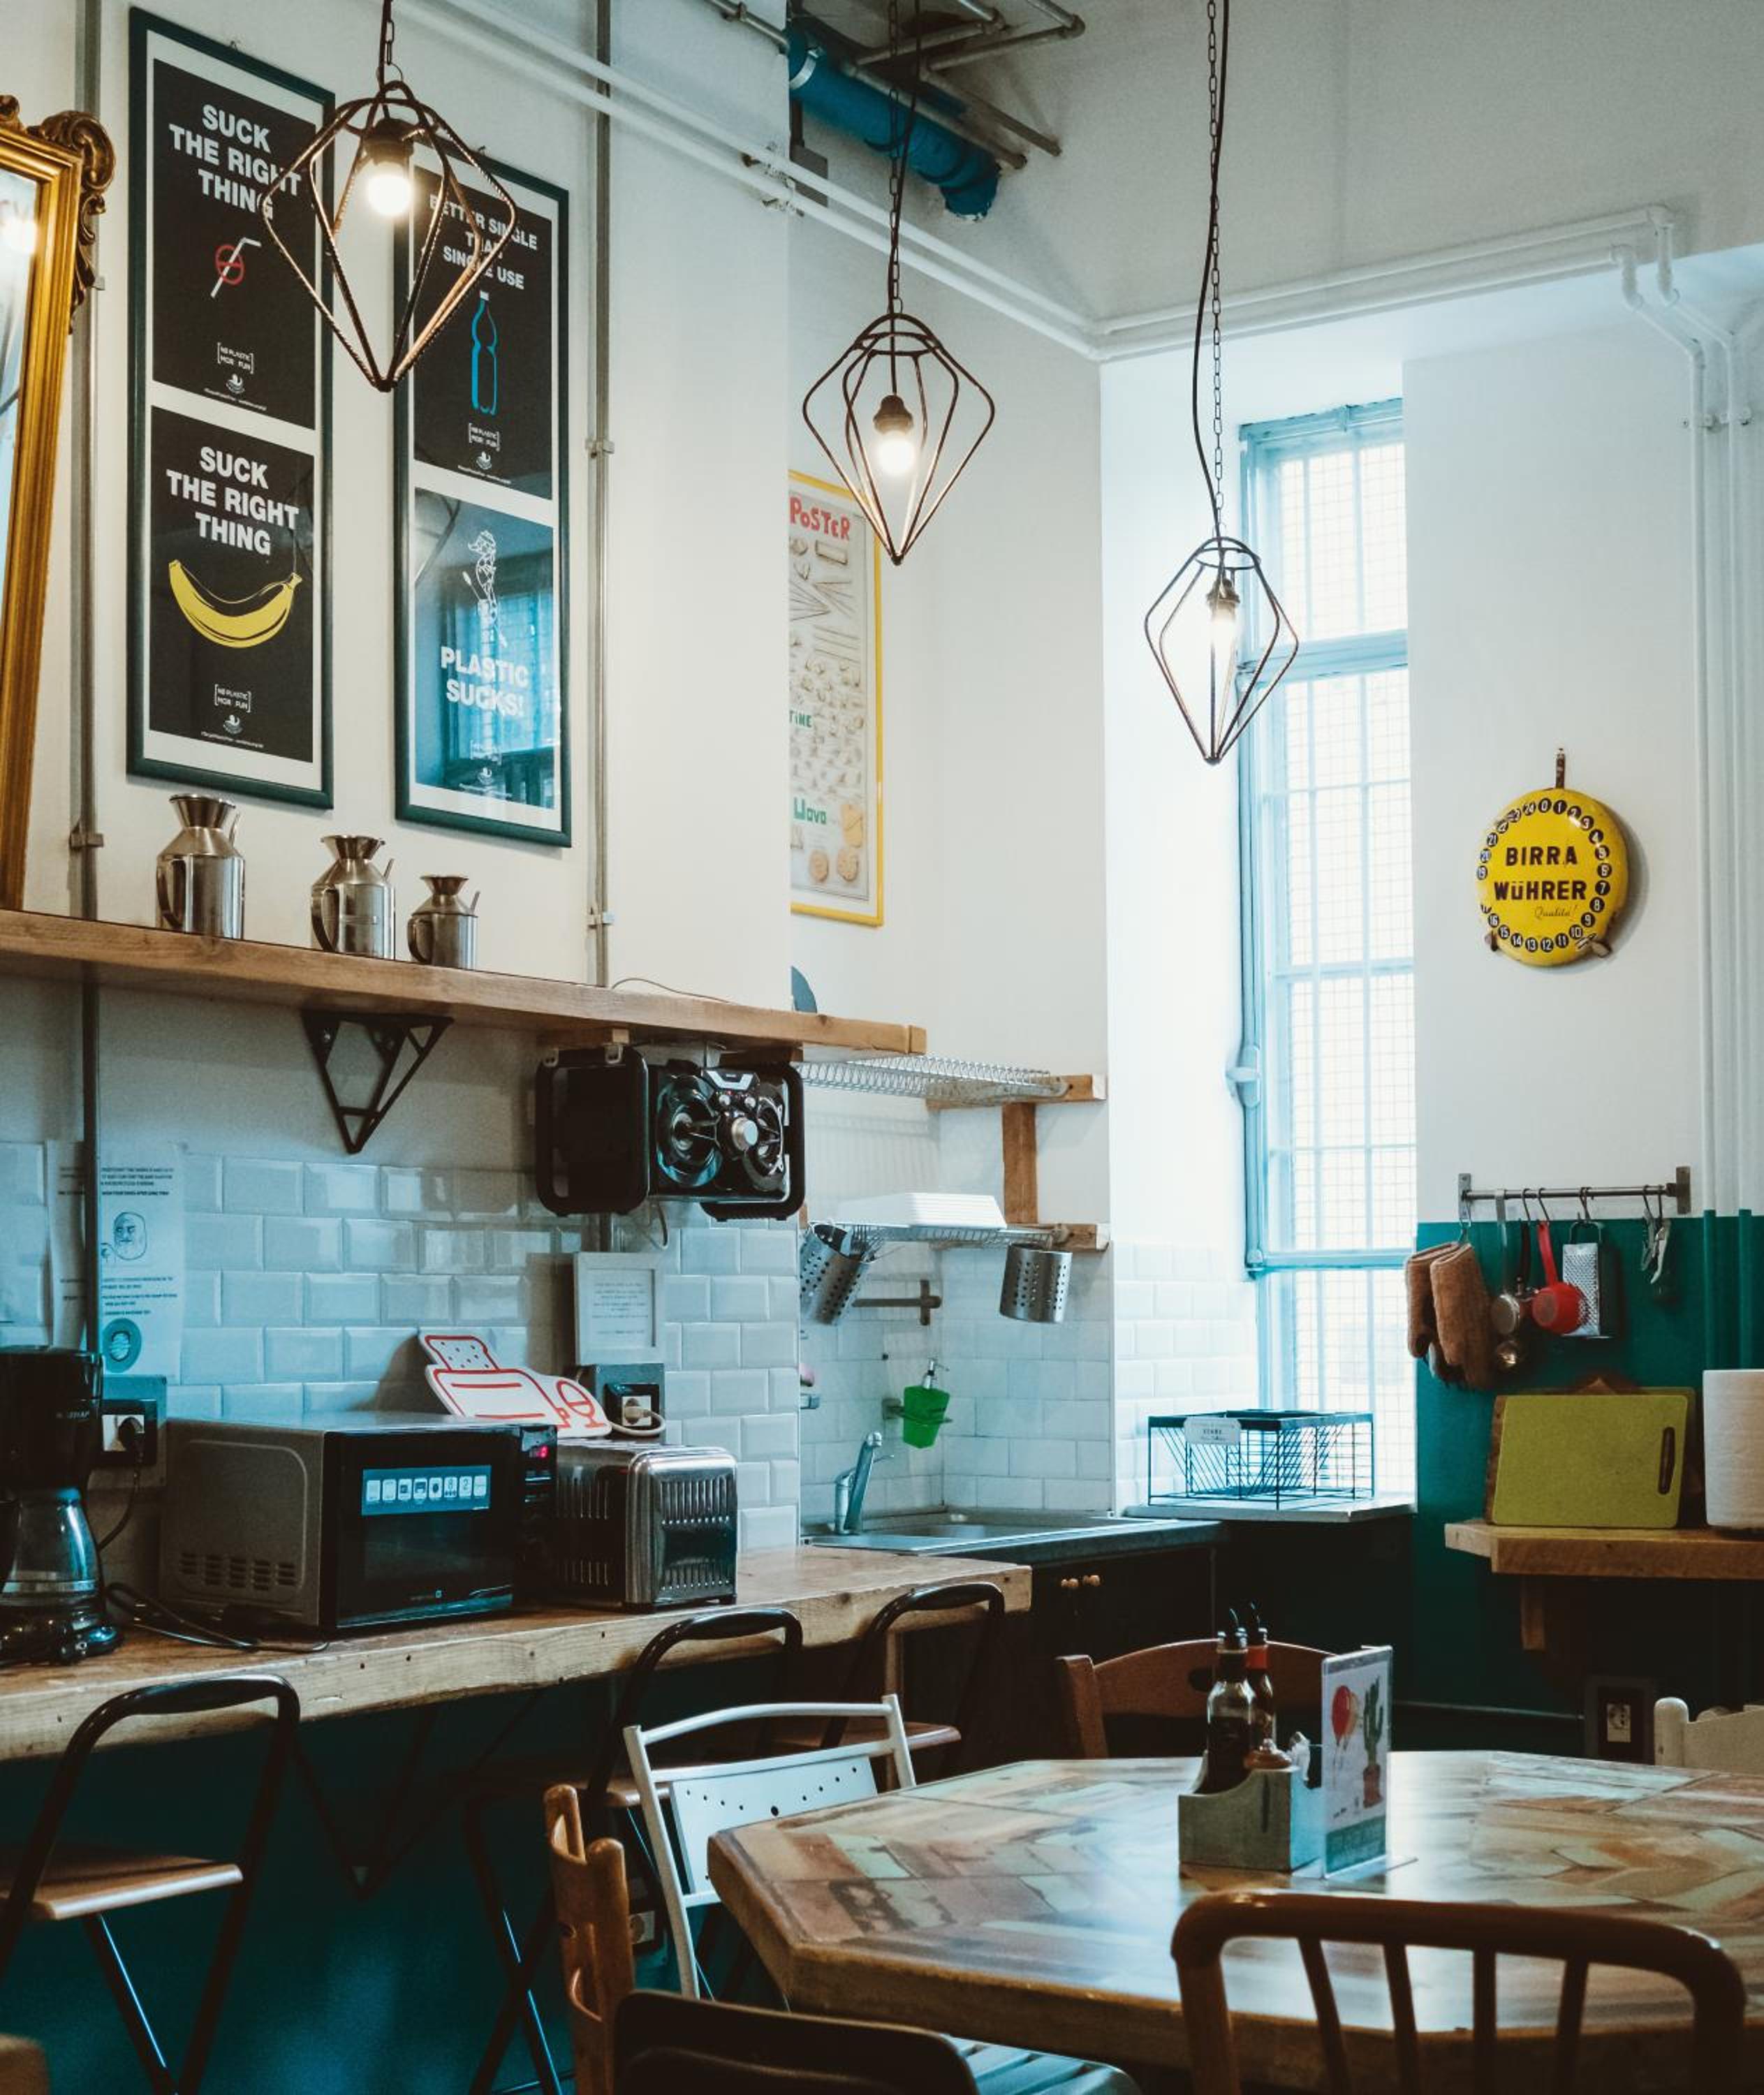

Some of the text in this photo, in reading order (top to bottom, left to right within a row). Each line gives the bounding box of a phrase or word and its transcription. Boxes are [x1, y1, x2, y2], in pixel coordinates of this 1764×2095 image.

[202, 104, 271, 154] SUCK
[168, 123, 302, 196] THE RIGHT
[198, 168, 274, 220] THING
[429, 193, 485, 230] BETTR
[497, 266, 525, 290] USE
[200, 446, 269, 490] SUCK
[166, 469, 300, 530] THE RIGHT
[195, 511, 271, 556] THING
[441, 646, 529, 686] PLASTIC
[1506, 845, 1578, 866] BIRRA
[1527, 939, 1536, 950] 13
[1542, 939, 1552, 950] 12
[1571, 926, 1582, 938] 10
